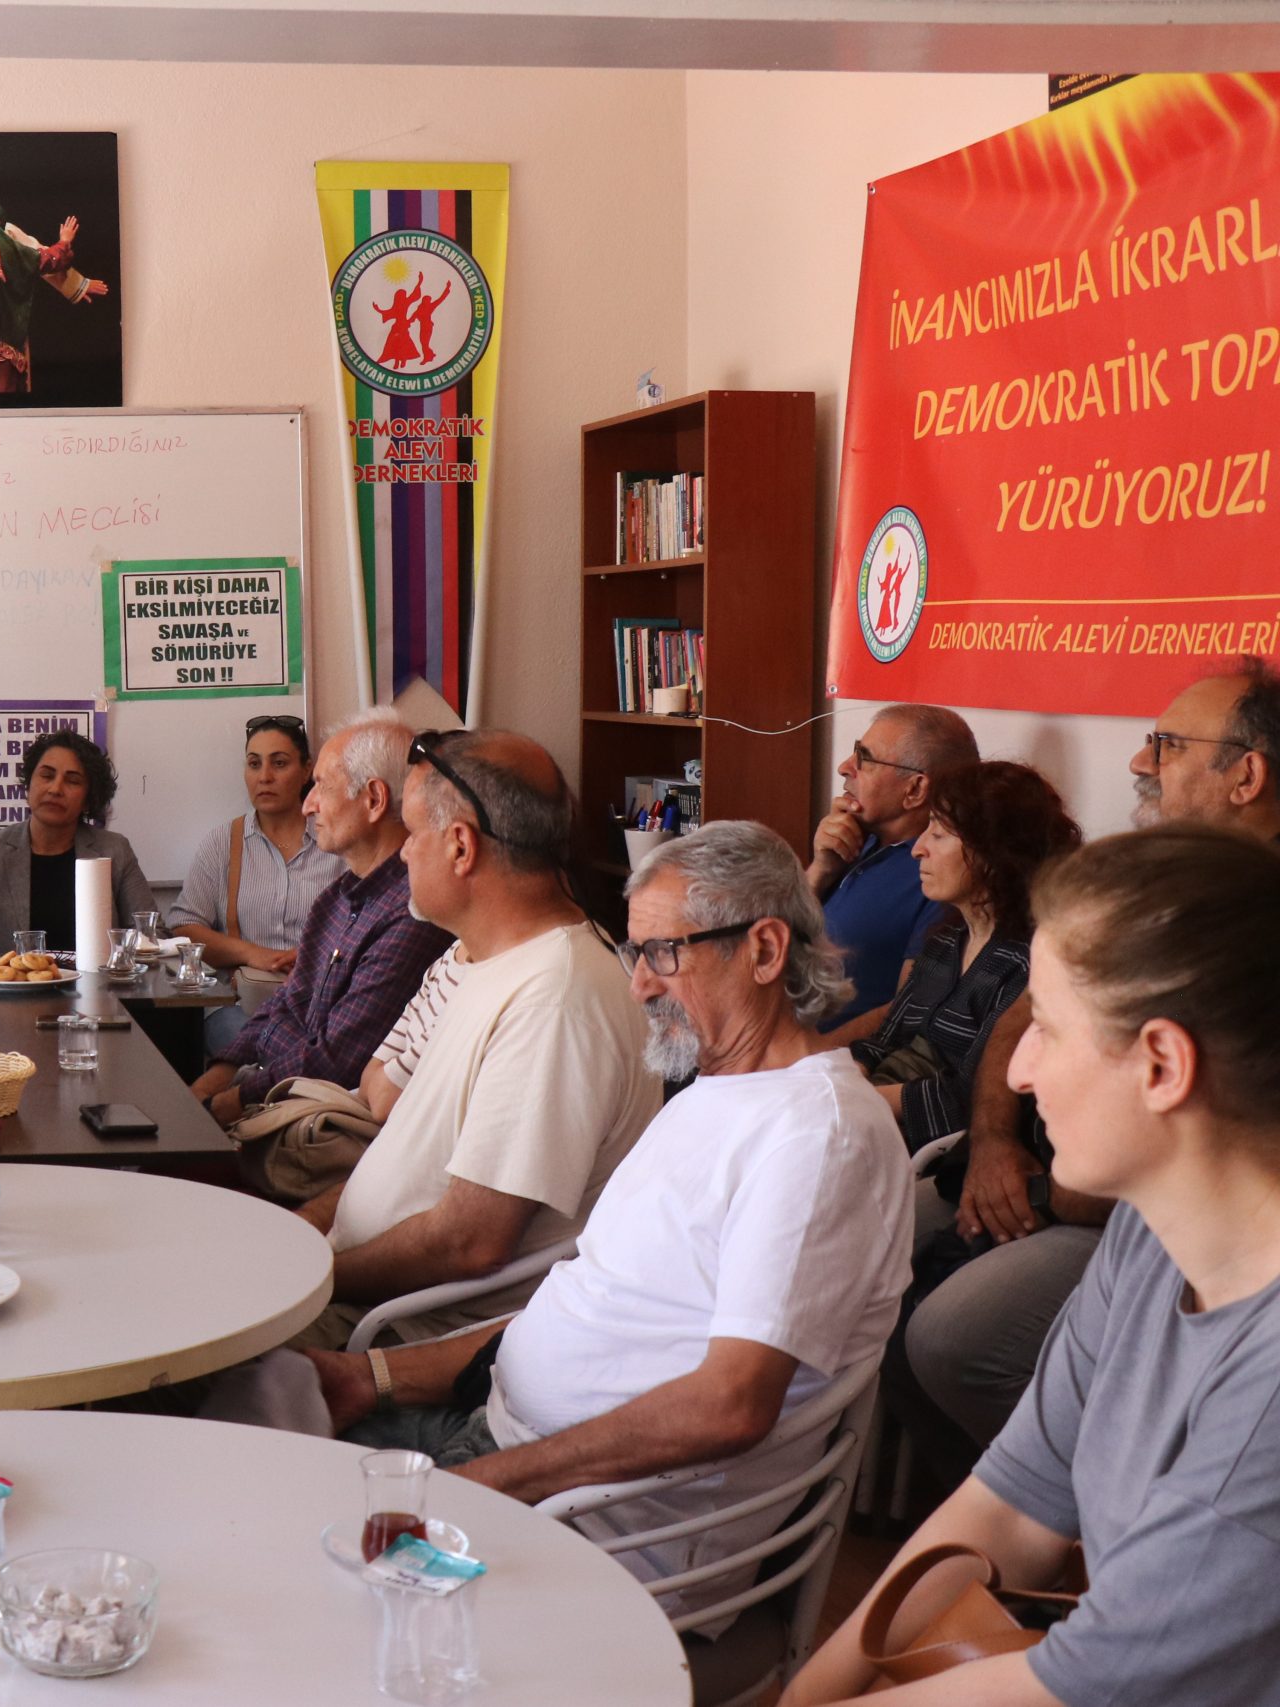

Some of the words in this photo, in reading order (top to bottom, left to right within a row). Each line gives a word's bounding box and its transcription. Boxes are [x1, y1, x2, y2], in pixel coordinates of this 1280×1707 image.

[343, 238, 396, 289] DEMOKRATİK
[399, 236, 428, 248] ALEVİ
[430, 241, 480, 289] DERNEKLERİ
[889, 248, 1100, 351] İNANCIMIZLA
[1110, 198, 1280, 299] İKRARL
[335, 293, 344, 320] DAD
[474, 295, 484, 318] KED
[337, 327, 385, 383] KOMELAYAN
[424, 379, 431, 389] A
[433, 327, 484, 386] DEMOKRATİK
[914, 338, 1170, 440] DEMOKRATİK
[1181, 327, 1280, 401] TOP
[348, 414, 484, 436] DEMOKRATİK
[384, 438, 443, 459] ALEVİ
[354, 460, 477, 483] DERNEKLERİ
[996, 449, 1270, 533] YÜRÜYORUZ!
[135, 578, 168, 596] BİR
[173, 576, 213, 597] KİŞİ
[218, 577, 270, 593] DAHA
[127, 597, 279, 618] EKSİLMİYECEĞİZ
[158, 623, 233, 641] SAVAŞA
[238, 629, 249, 637] VE
[929, 615, 1053, 652] DEMOKRATİK
[1053, 616, 1129, 654] ALEVİ
[1129, 611, 1280, 655] DERNEKLERİ
[151, 641, 257, 662] SÖMÜRÜYE
[176, 667, 216, 683] SON
[221, 667, 233, 682] !!
[7, 715, 78, 734] BENİM
[6, 740, 33, 756] BE
